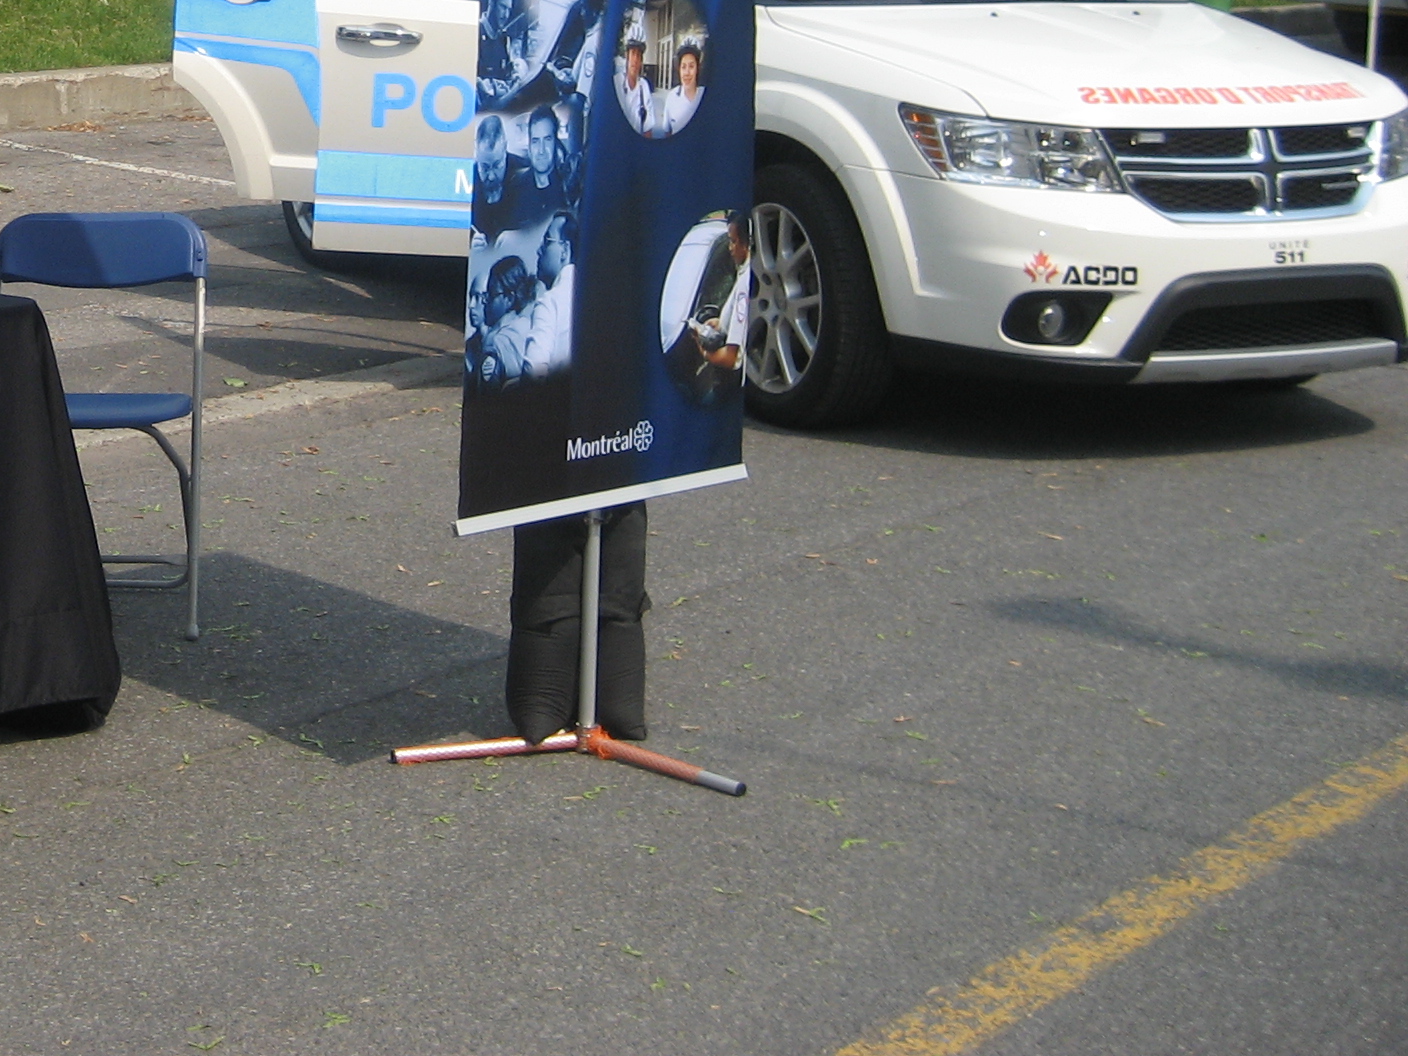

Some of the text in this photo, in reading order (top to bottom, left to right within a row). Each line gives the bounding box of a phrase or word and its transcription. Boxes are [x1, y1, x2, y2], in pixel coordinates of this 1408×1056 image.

[1274, 250, 1304, 264] 511
[1061, 265, 1139, 286] ACDO
[566, 428, 633, 461] Montréal
